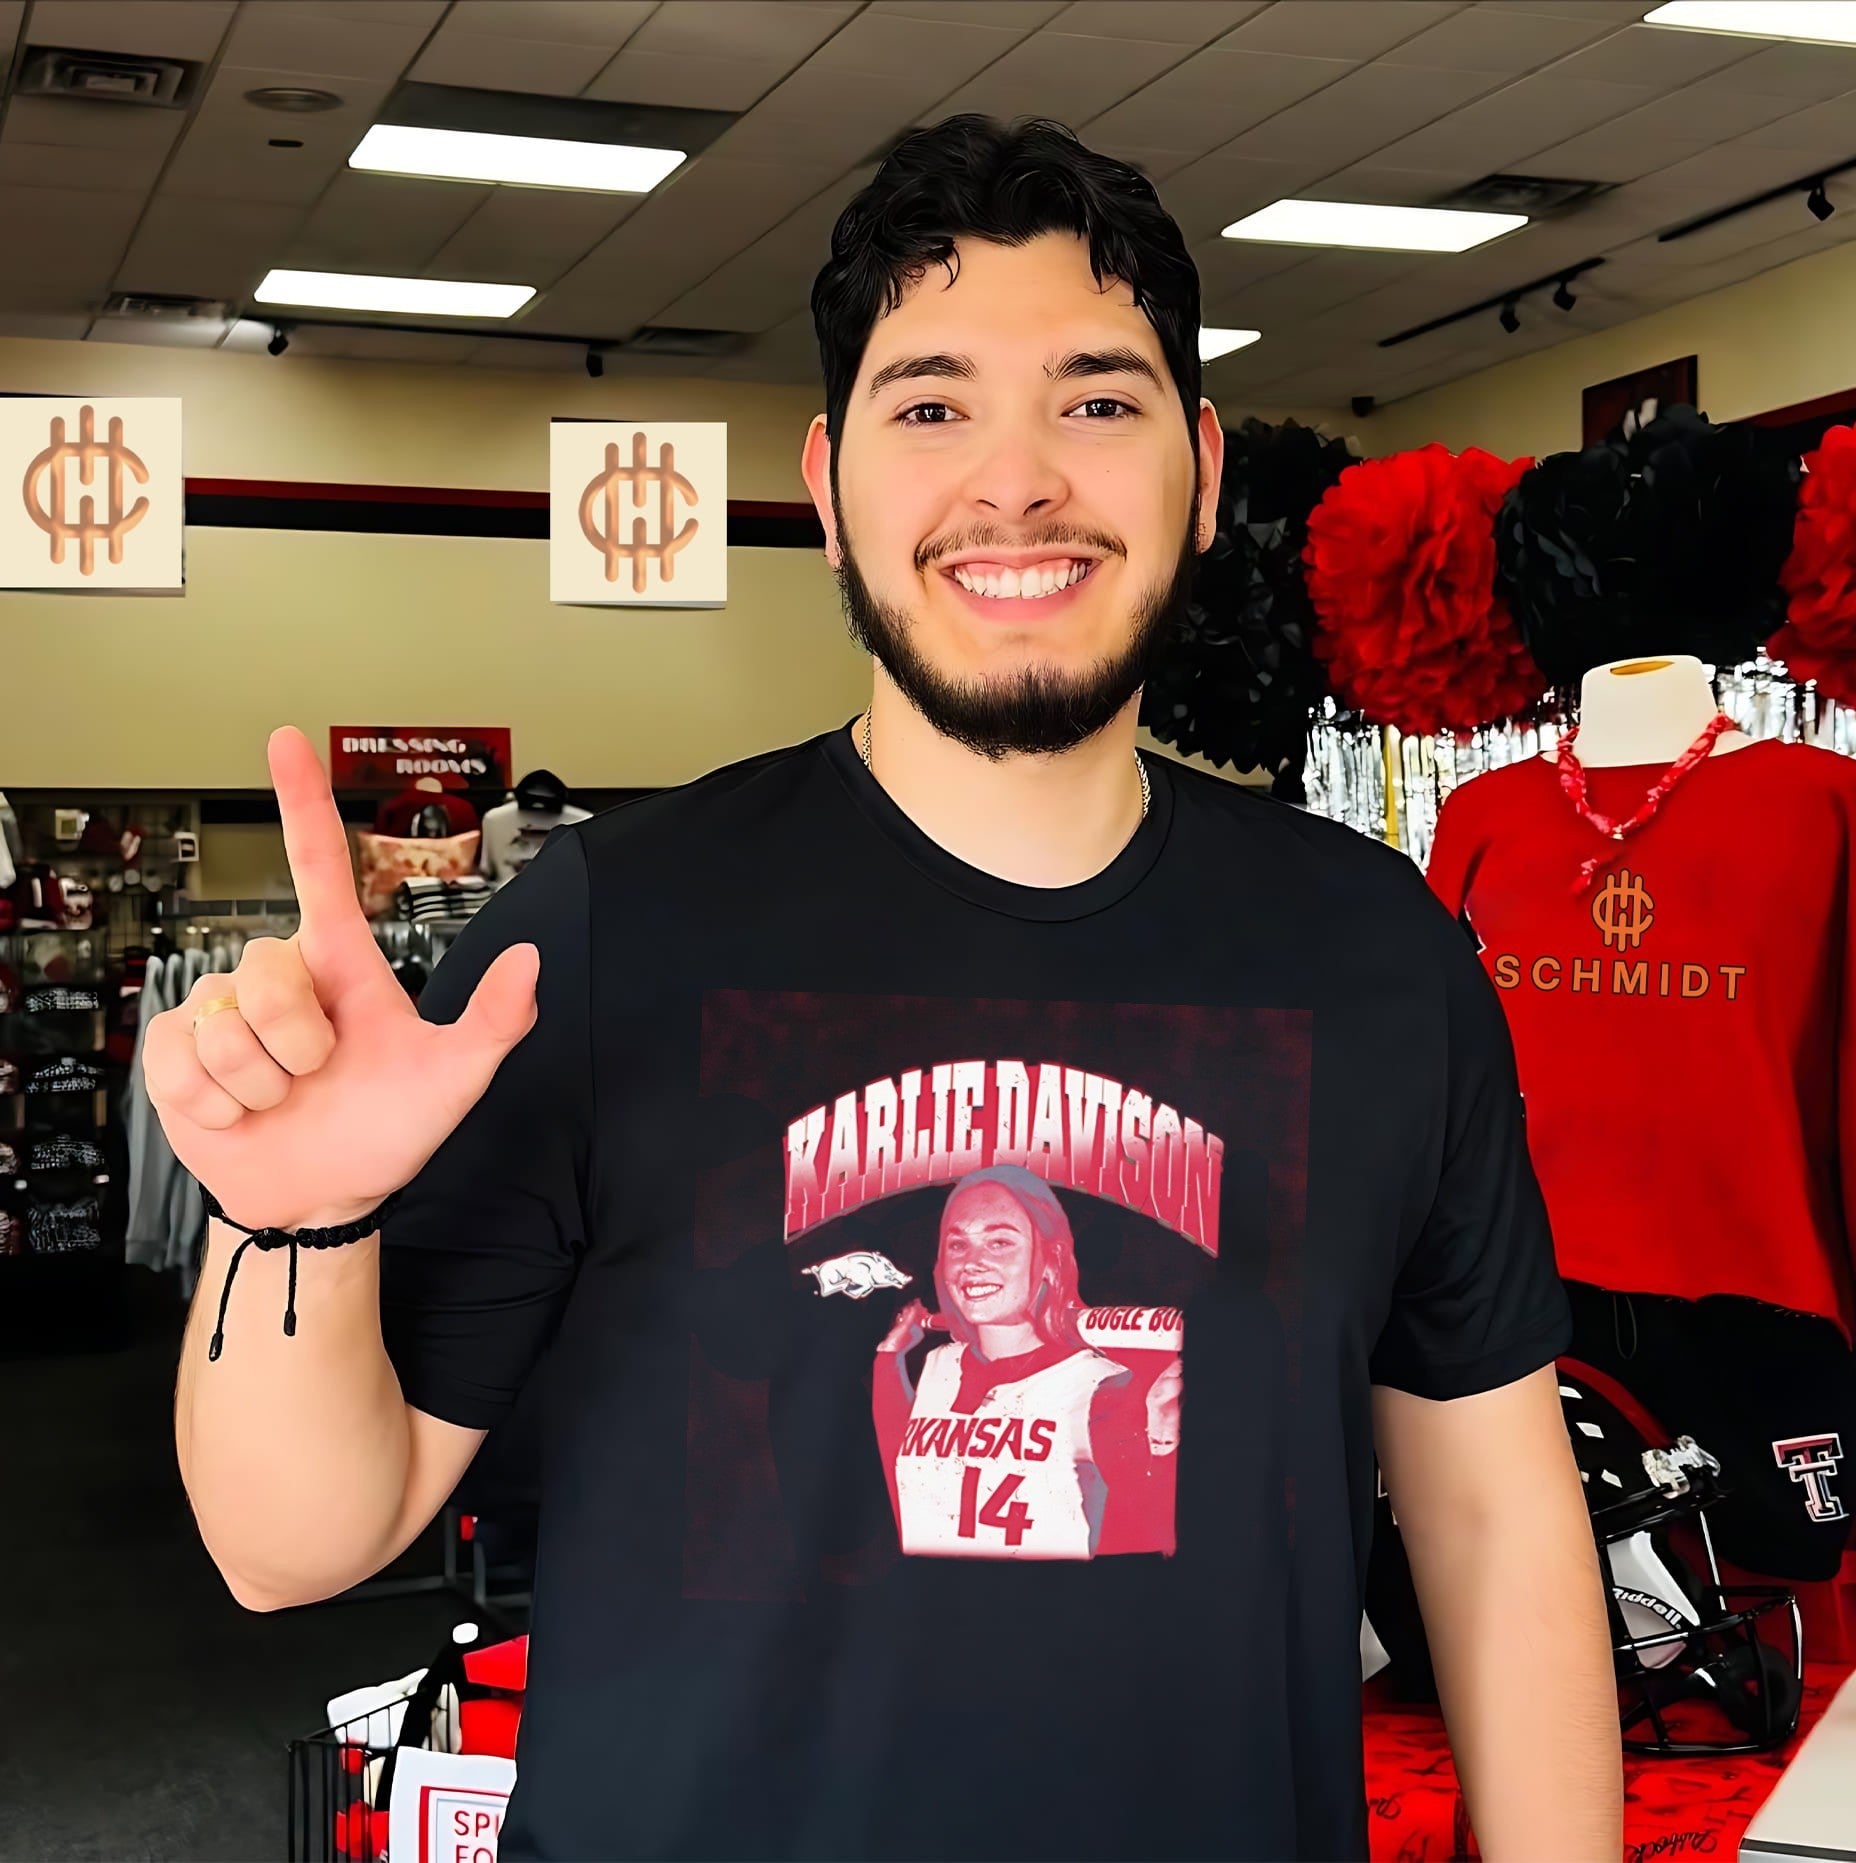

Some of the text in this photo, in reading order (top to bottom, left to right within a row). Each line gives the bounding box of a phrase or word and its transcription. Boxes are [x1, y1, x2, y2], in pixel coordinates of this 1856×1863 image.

[342, 736, 467, 754] DRESSING
[396, 757, 487, 775] ROOMS
[1494, 953, 1747, 1001] SCHMIDT
[783, 1059, 1225, 1258] KARLIE DAVISON
[957, 1465, 1035, 1546] 14
